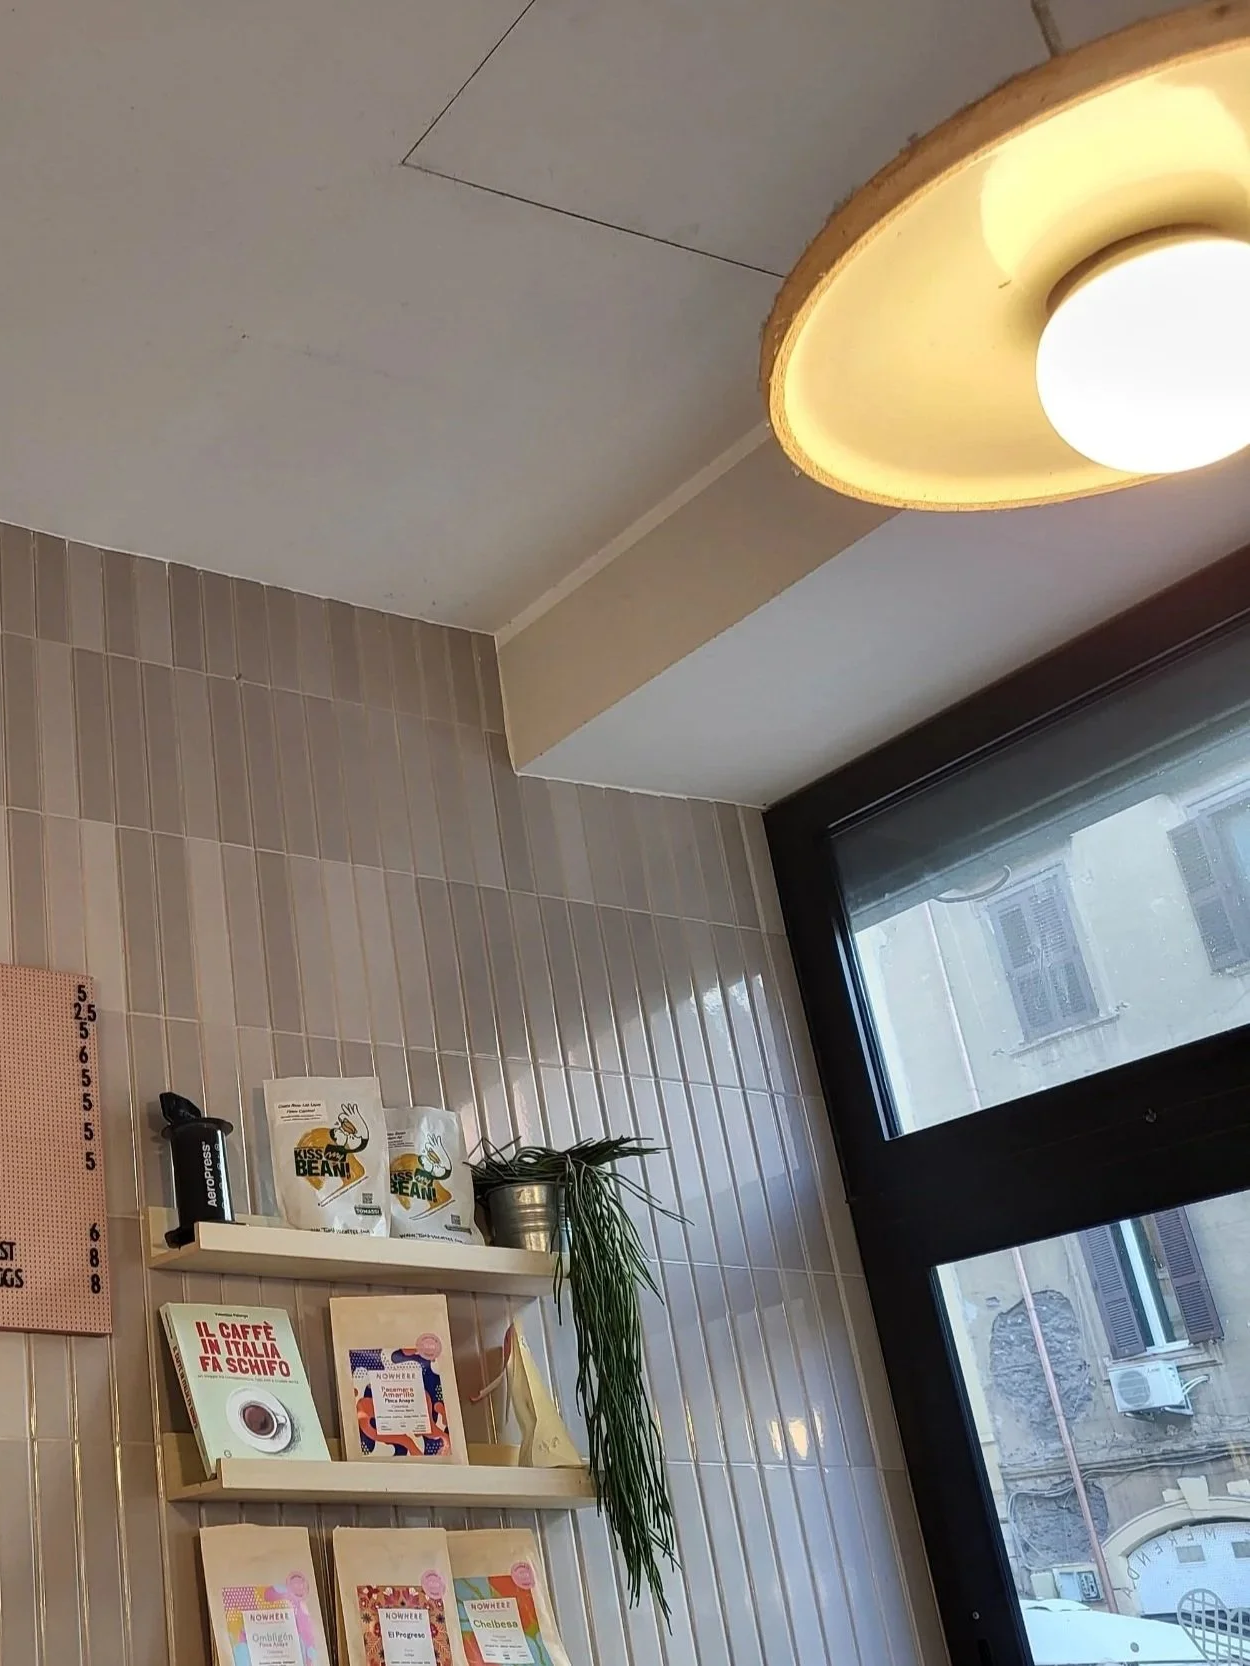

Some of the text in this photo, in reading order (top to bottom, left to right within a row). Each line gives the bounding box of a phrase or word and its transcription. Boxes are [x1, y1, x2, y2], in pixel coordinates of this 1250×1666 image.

[77, 985, 87, 1002] 5
[73, 1002, 97, 1022] 2.5
[79, 1022, 89, 1040] 5
[78, 1046, 89, 1064] 6
[81, 1069, 92, 1087] 5
[82, 1093, 93, 1112] 5
[84, 1122, 94, 1141] 5
[85, 1152, 96, 1171] 5
[294, 1148, 323, 1161] KISS
[201, 1144, 218, 1207] AeroPress
[294, 1160, 351, 1180] BEAN!
[89, 1223, 100, 1242] 6
[89, 1248, 100, 1268] 8
[90, 1274, 101, 1294] 8
[195, 1321, 216, 1338] IL
[218, 1321, 276, 1341] CAFFÈ
[200, 1339, 281, 1359] IN ITALIA
[199, 1356, 291, 1377] FA SCHIFO
[376, 1372, 416, 1380] NOWHERE
[470, 1602, 511, 1610] NOWHERE
[250, 1612, 290, 1622] NOWHERE
[385, 1612, 423, 1621] NOWHERE
[473, 1619, 519, 1629] Chelbesa
